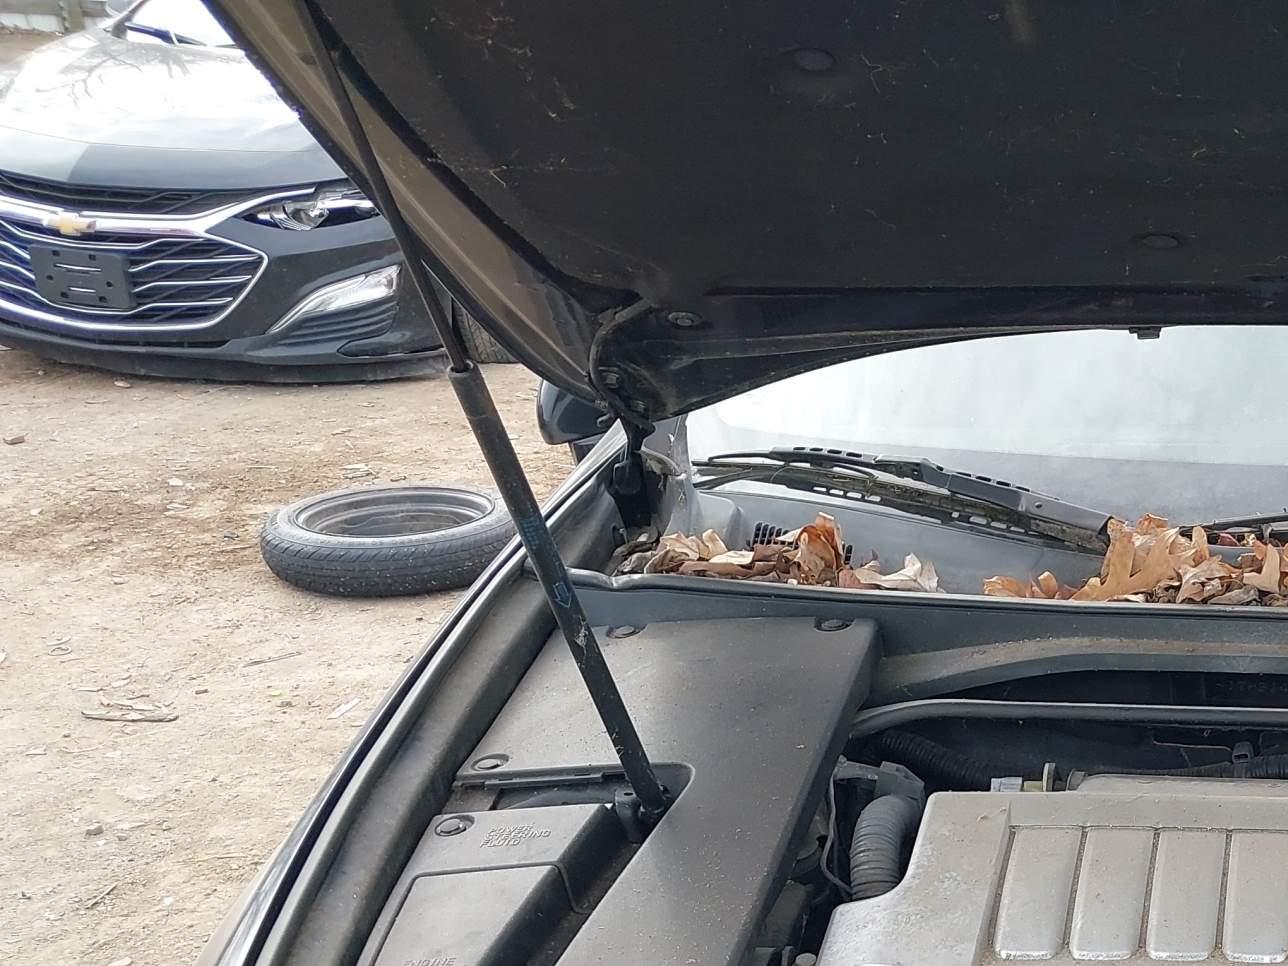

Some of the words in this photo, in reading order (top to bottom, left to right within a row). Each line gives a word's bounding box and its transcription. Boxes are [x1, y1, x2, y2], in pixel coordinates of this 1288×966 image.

[486, 829, 552, 841] STEERING
[488, 825, 535, 836] POWER
[480, 838, 521, 849] FLUID
